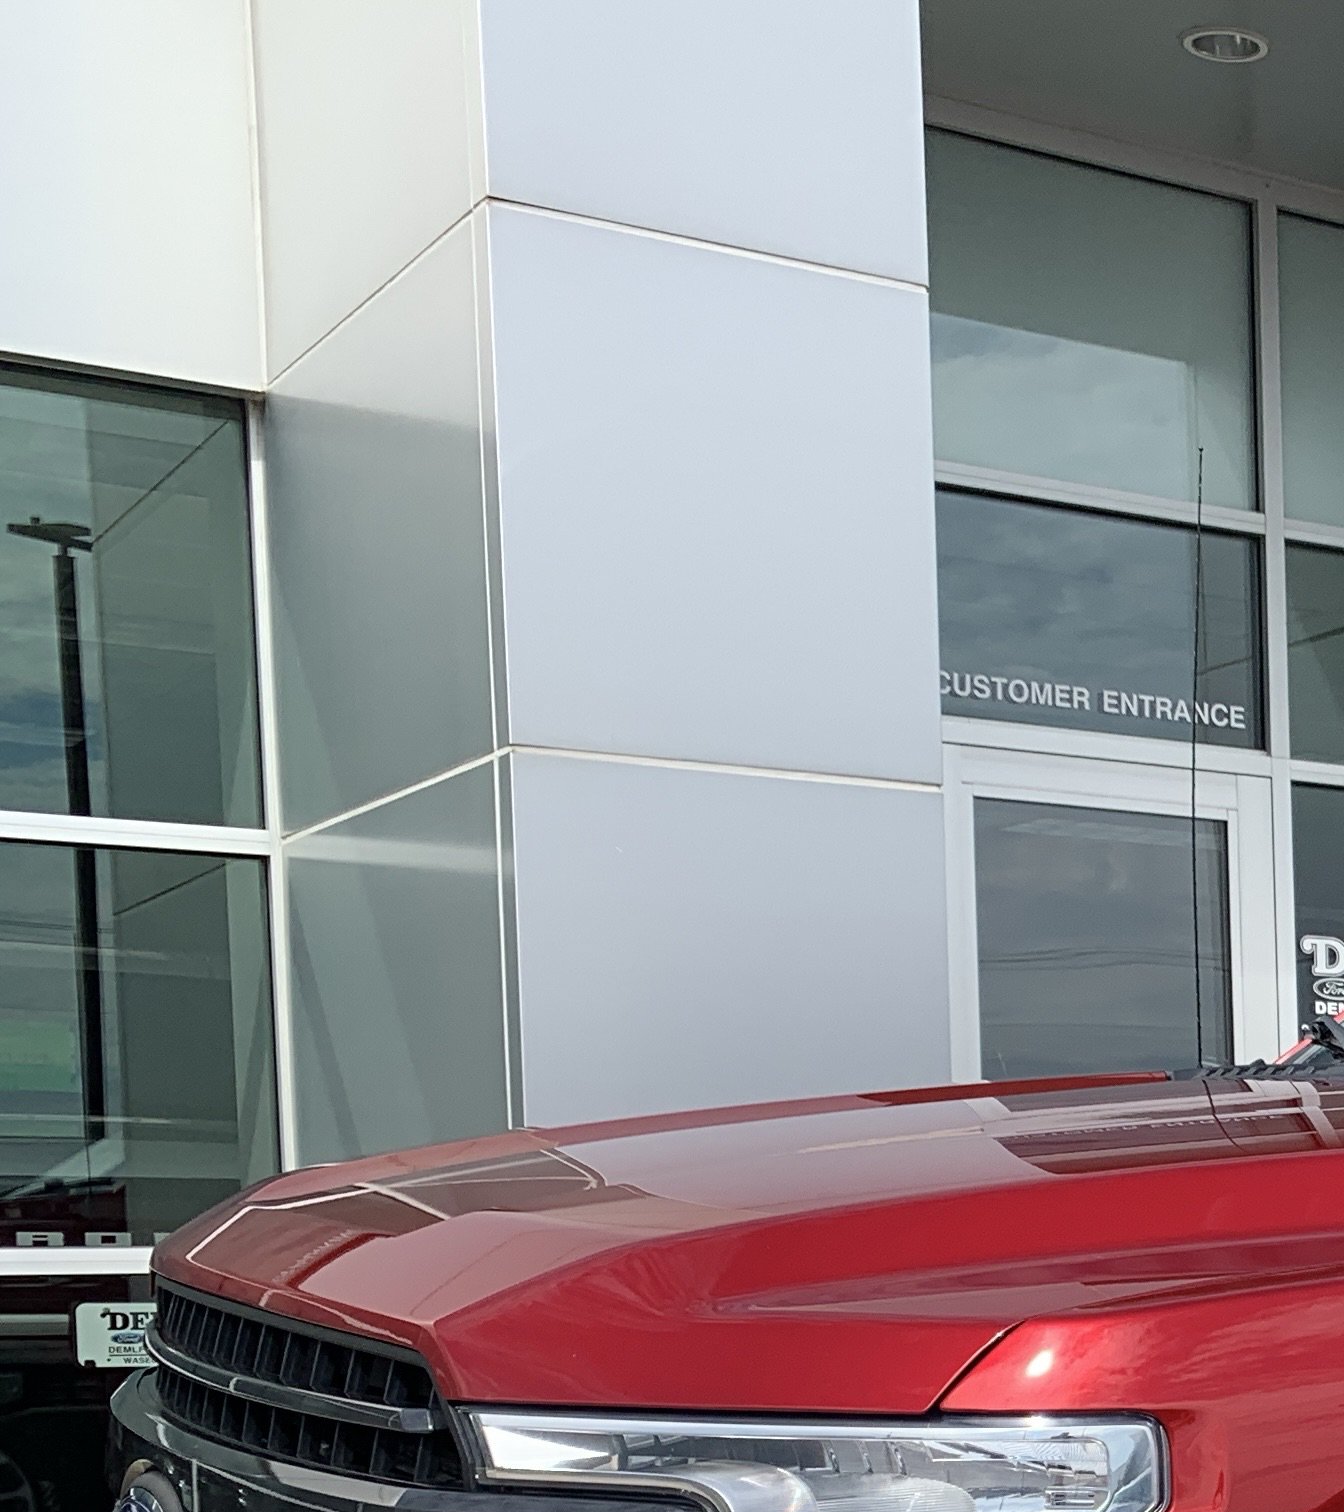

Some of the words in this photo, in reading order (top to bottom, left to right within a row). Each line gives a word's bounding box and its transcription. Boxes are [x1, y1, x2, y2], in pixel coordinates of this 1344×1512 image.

[939, 670, 1091, 711] CUSTOMER
[1102, 690, 1247, 729] ENTRANCE
[100, 1311, 157, 1331] DE
